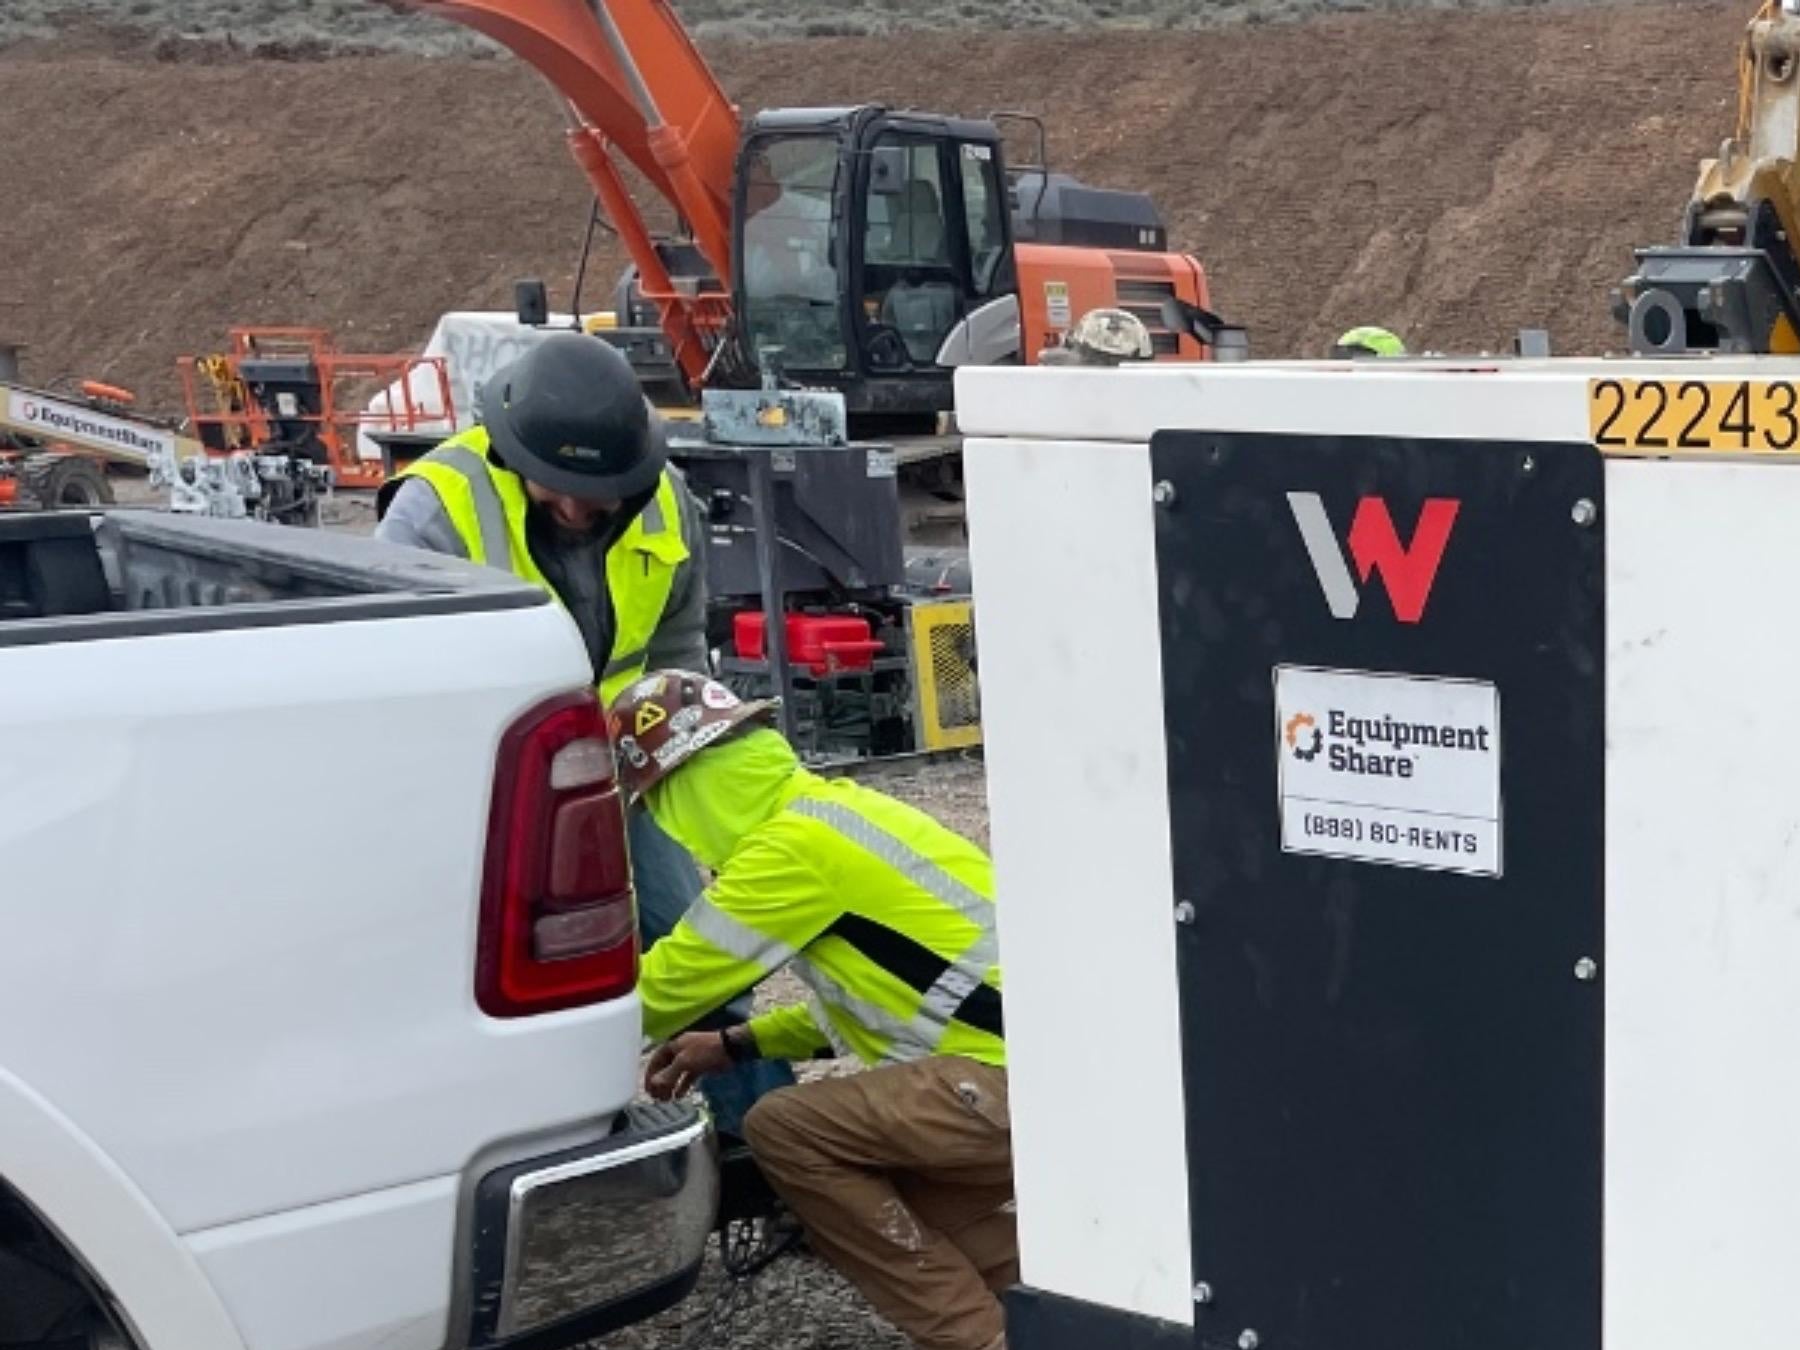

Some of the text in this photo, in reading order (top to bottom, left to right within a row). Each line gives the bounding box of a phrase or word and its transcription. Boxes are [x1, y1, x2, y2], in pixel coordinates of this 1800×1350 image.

[1328, 709, 1489, 753] Equipment
[1328, 743, 1414, 780] Share
[1304, 812, 1363, 842] (888)
